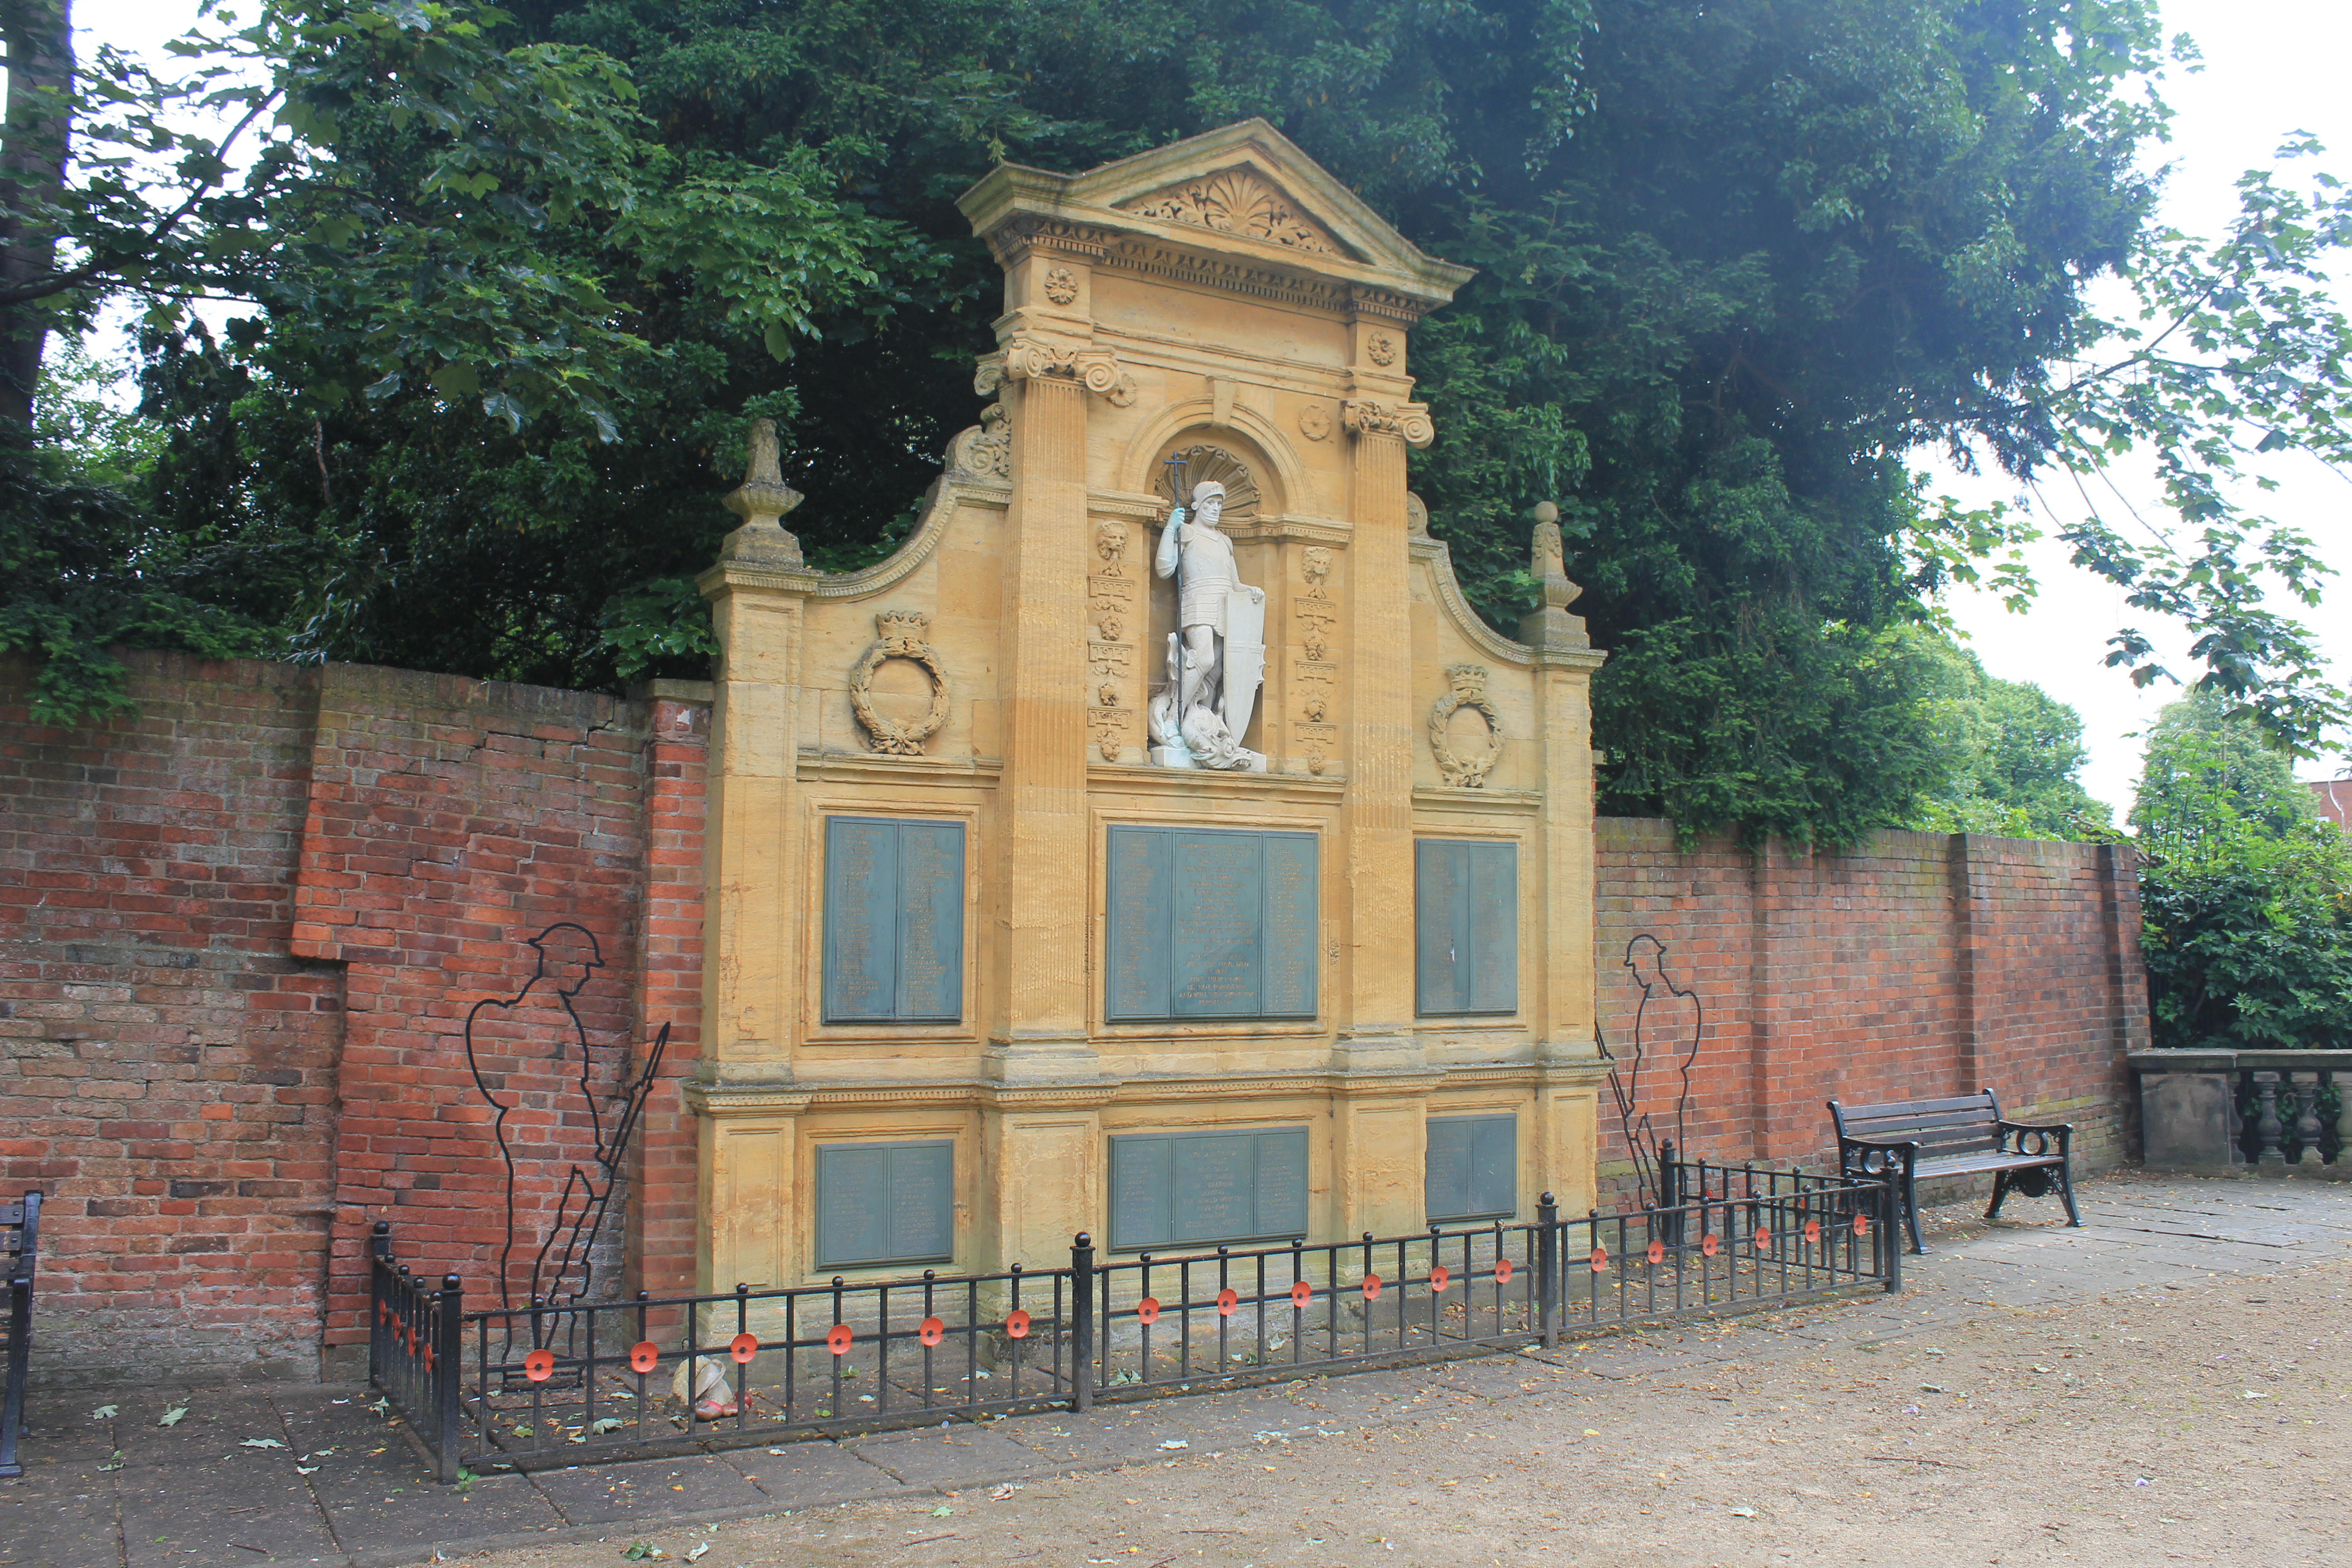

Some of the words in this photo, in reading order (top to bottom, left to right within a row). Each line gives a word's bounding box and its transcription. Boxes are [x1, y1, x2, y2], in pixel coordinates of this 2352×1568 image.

[1096, 583, 1126, 595] 1914
[1095, 647, 1124, 660] 1915
[1094, 712, 1123, 725] 1916
[1303, 728, 1328, 740] 1919
